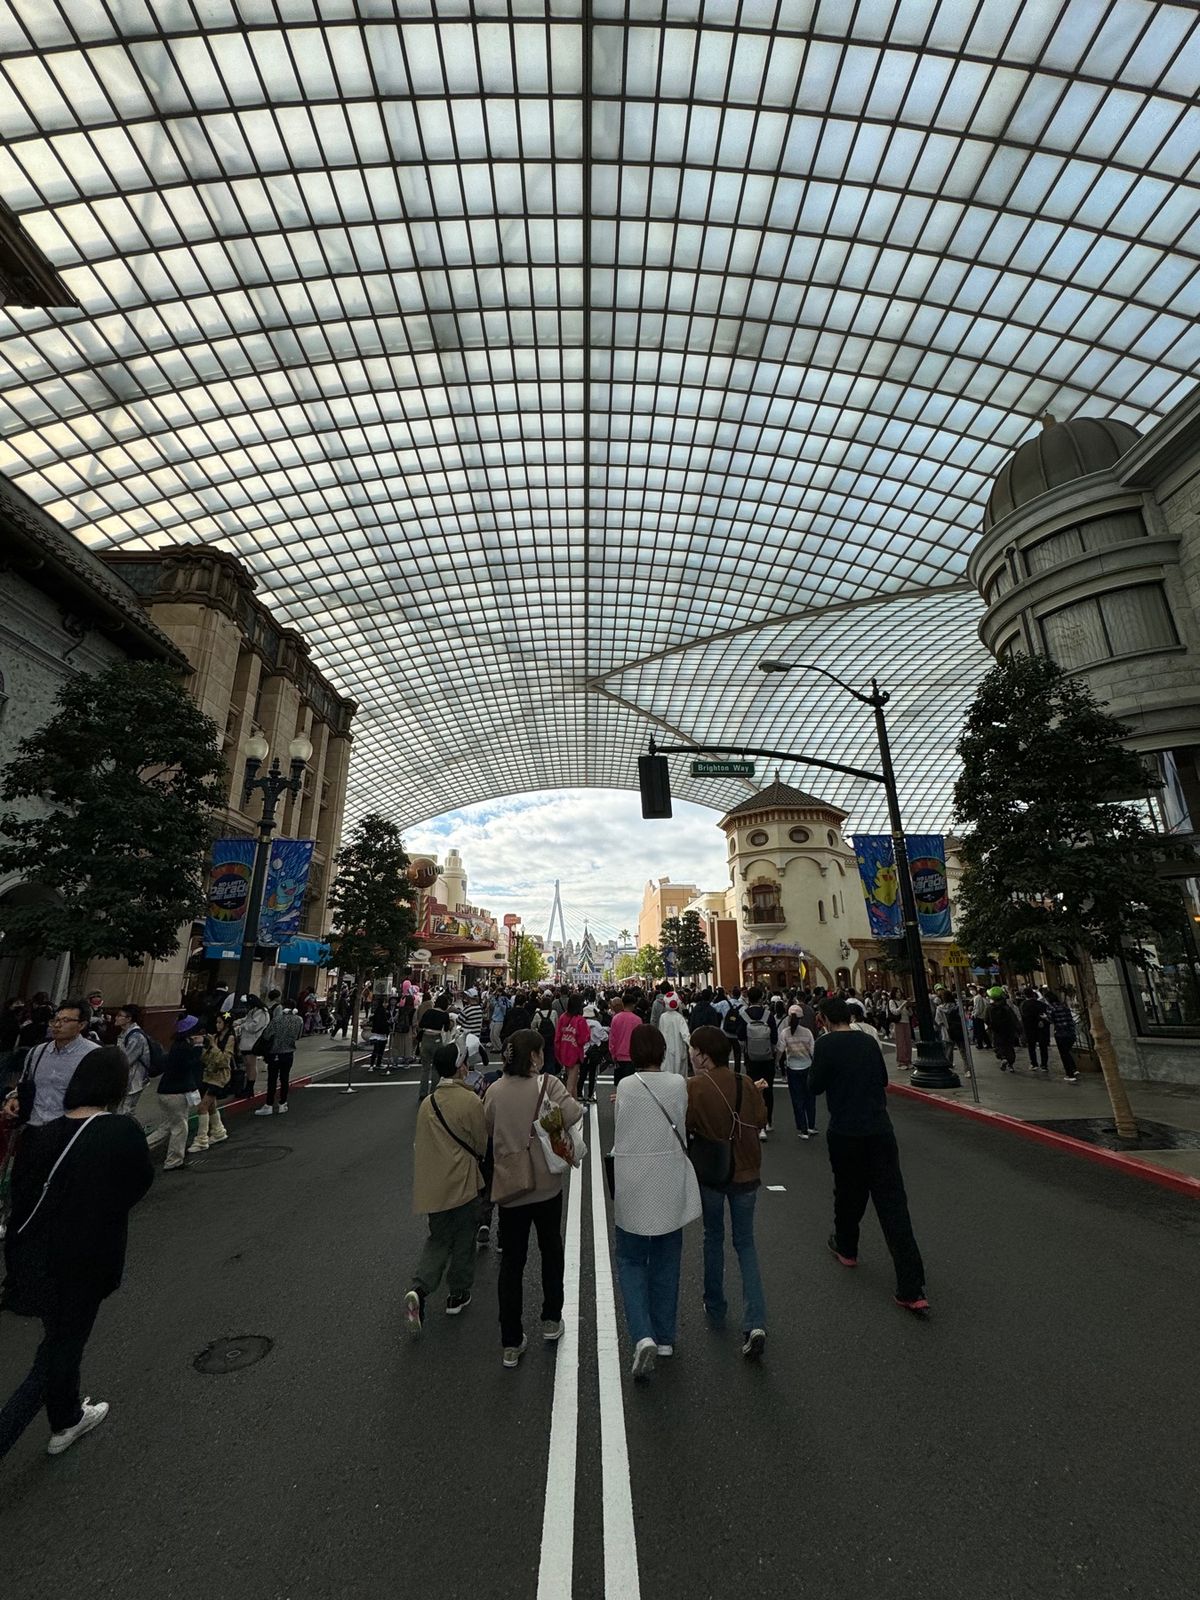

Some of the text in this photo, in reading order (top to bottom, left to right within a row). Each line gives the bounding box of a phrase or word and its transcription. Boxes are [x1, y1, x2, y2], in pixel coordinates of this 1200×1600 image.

[698, 764, 749, 772] Brighton Way
[948, 956, 964, 964] STOP
